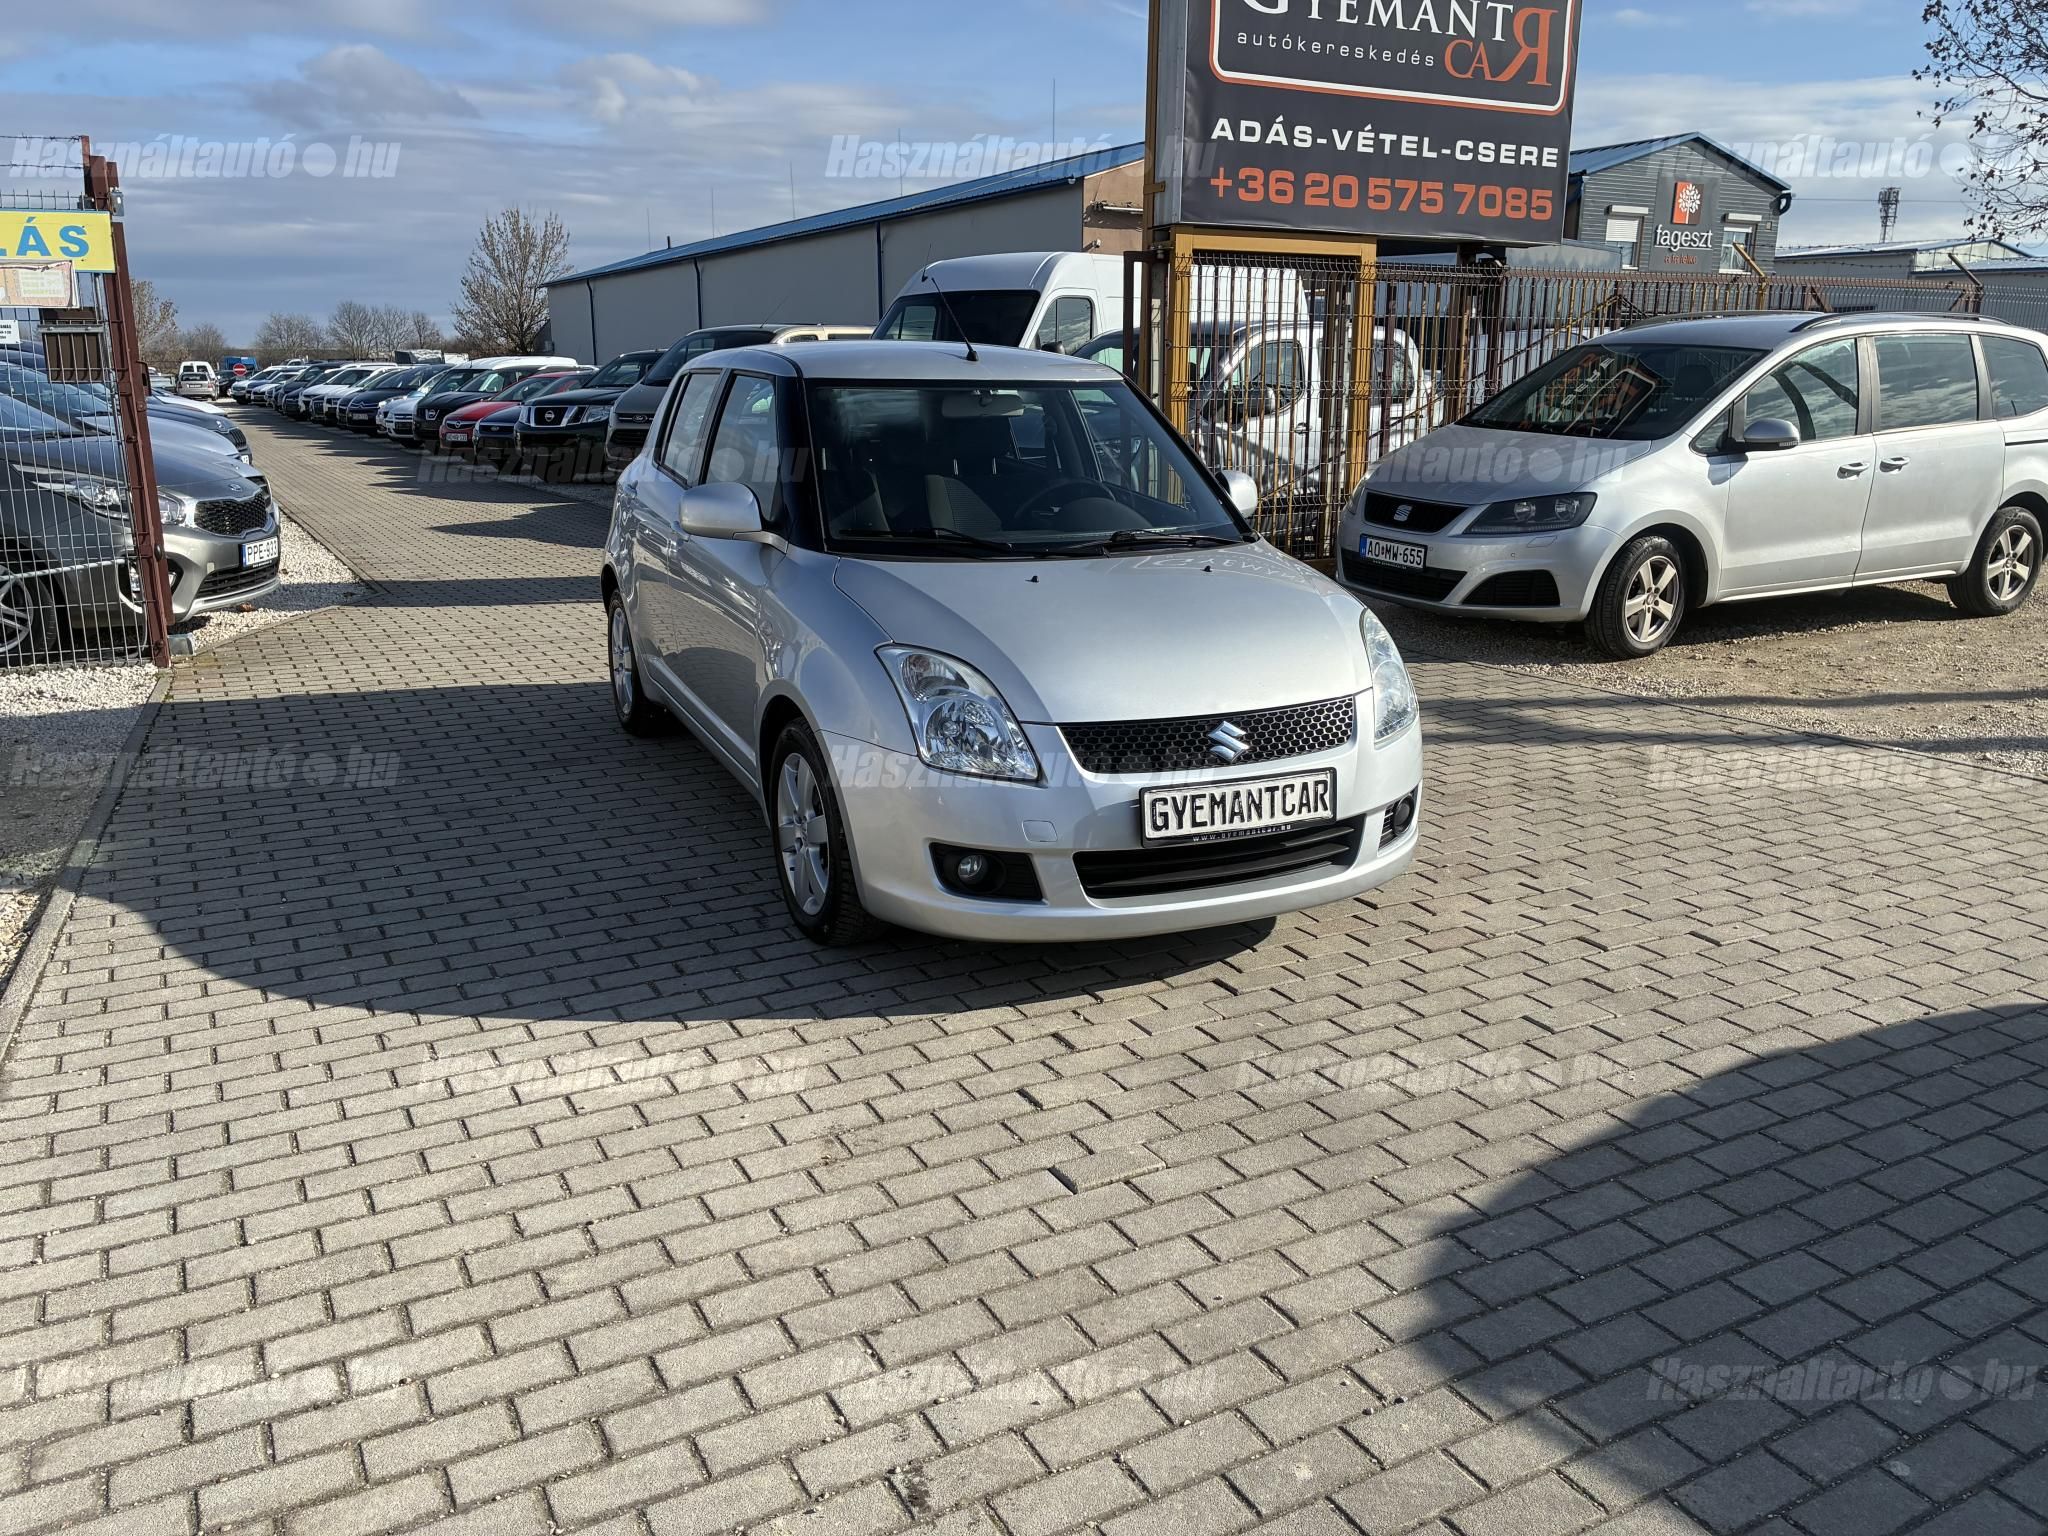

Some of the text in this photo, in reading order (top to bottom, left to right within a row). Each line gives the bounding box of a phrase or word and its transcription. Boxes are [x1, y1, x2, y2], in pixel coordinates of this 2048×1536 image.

[1237, 31, 1435, 67] autókereskedés
[1210, 115, 1559, 168] ADÁS-VÉTEL-CSERE
[1210, 167, 1553, 220] +36 20 575 7085
[1656, 224, 1713, 251] fageszt
[1151, 779, 1329, 832] GYEMANTCAR
